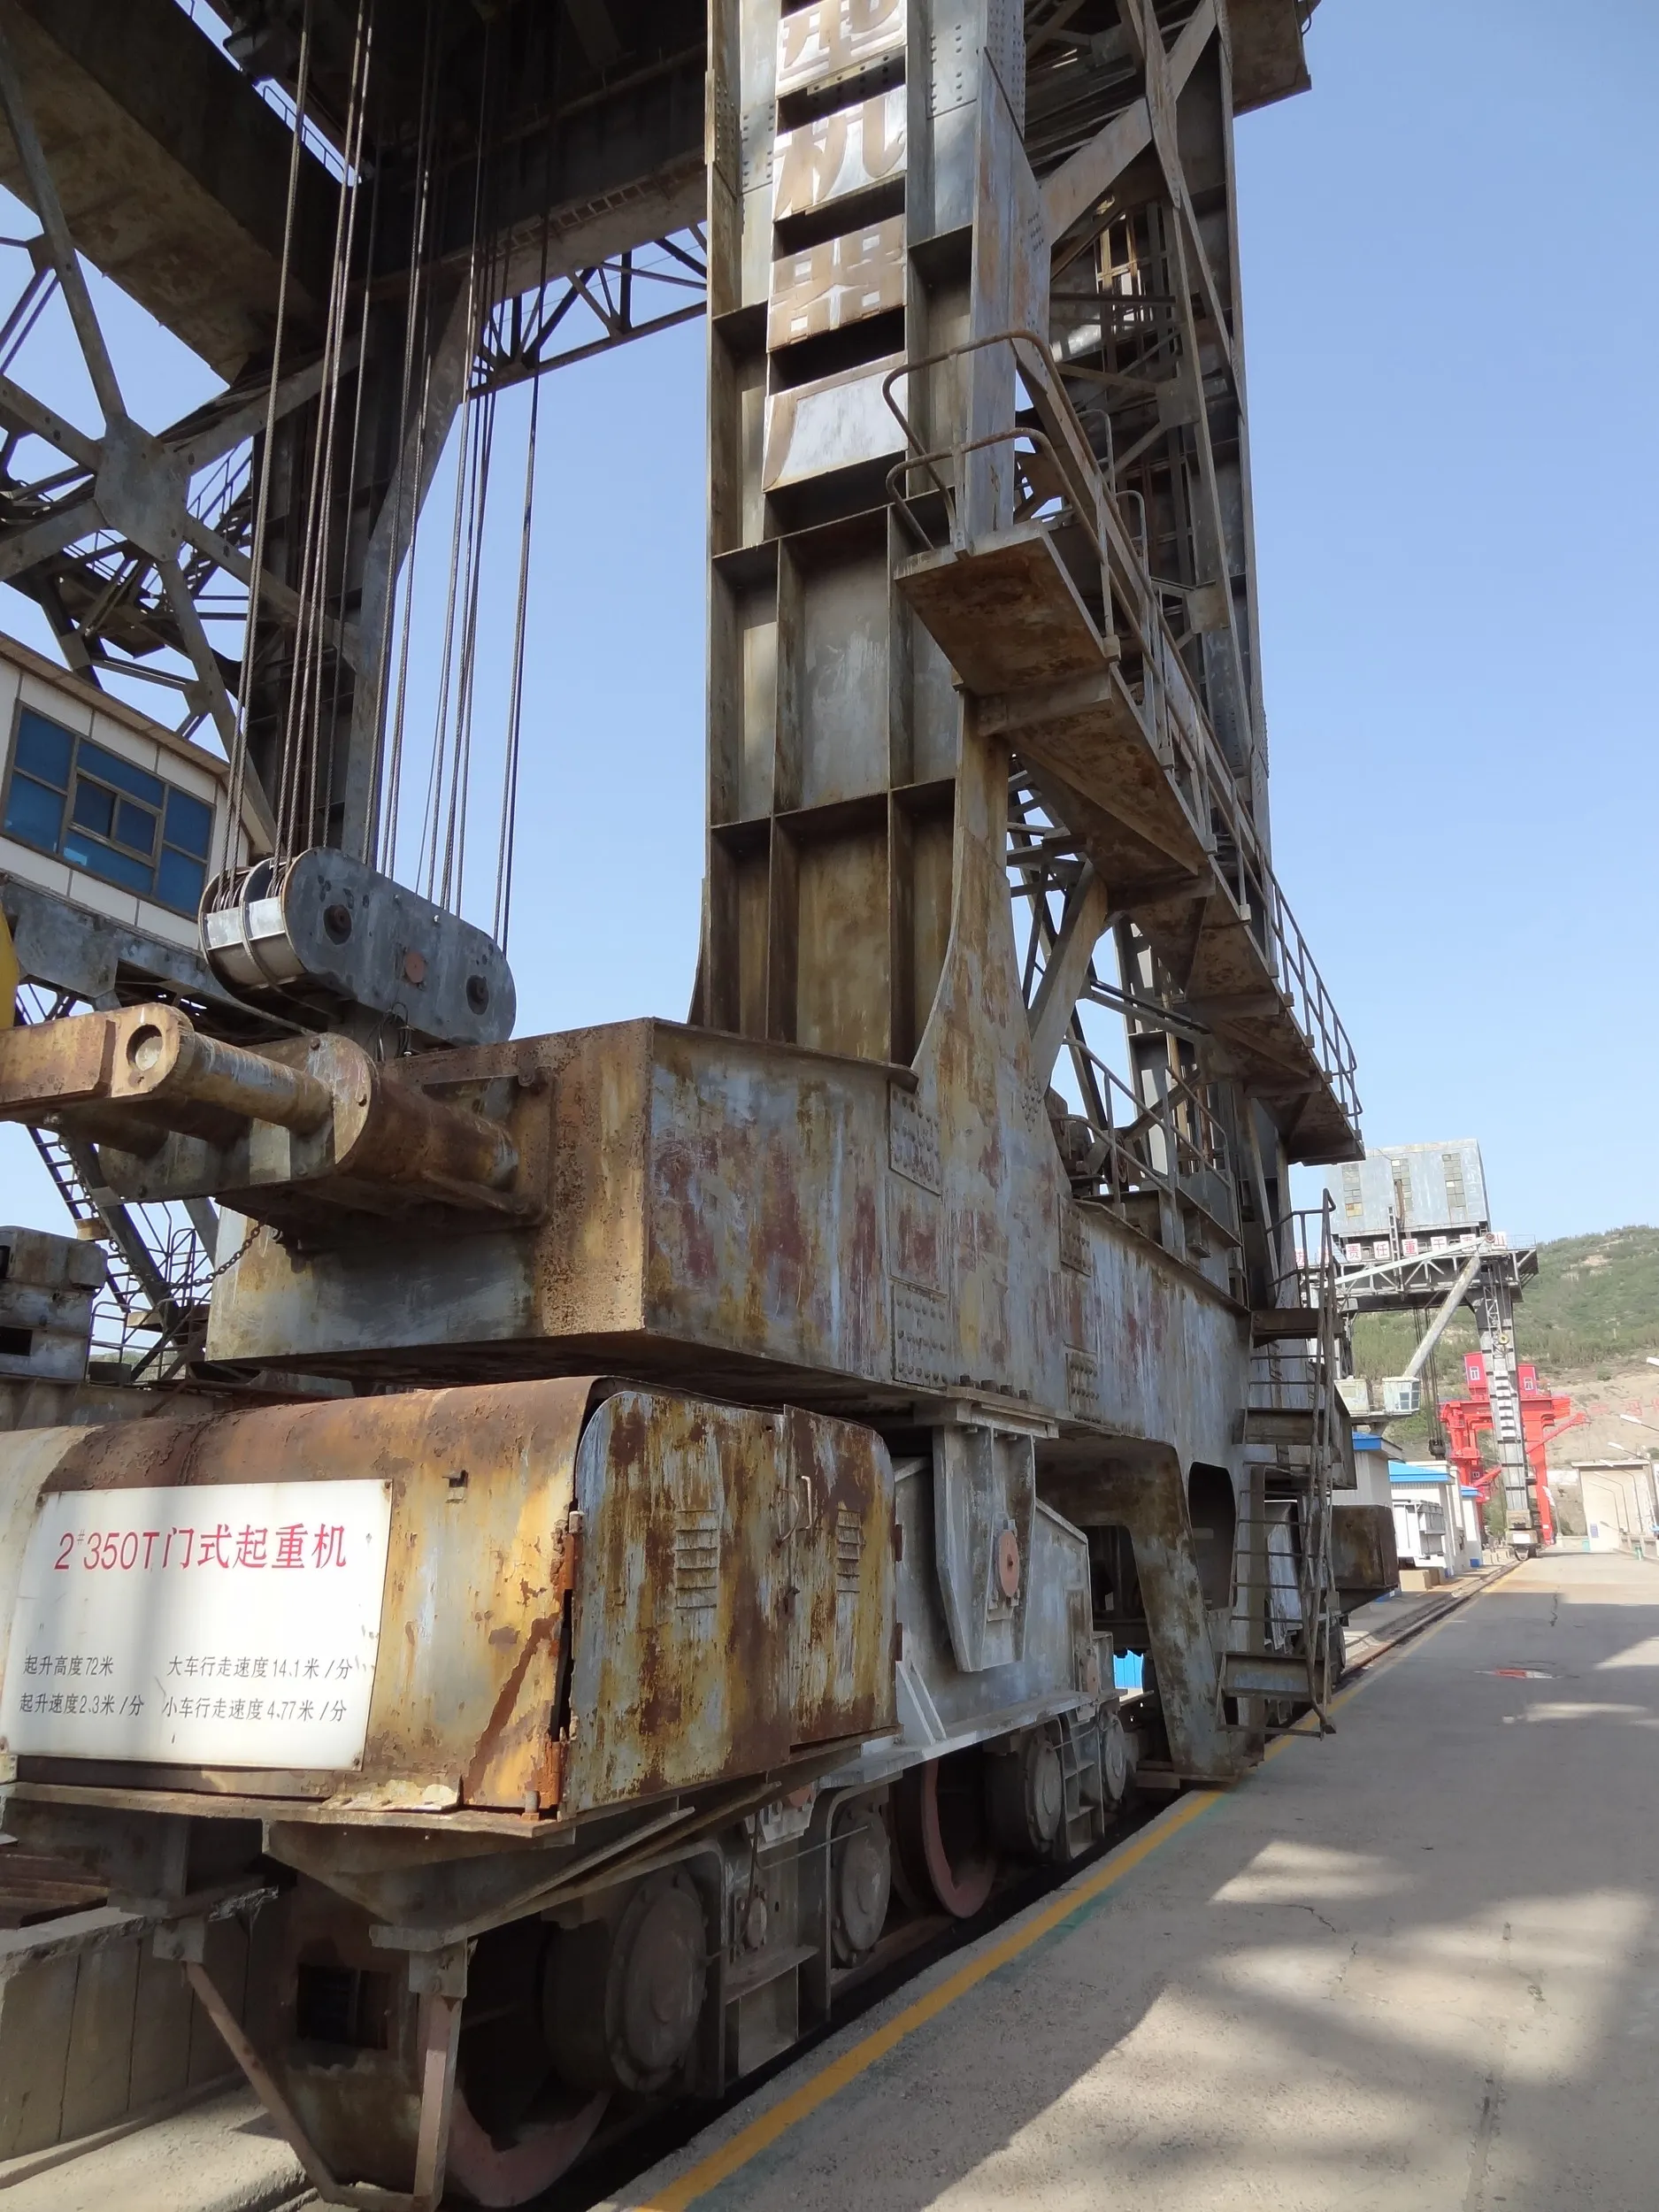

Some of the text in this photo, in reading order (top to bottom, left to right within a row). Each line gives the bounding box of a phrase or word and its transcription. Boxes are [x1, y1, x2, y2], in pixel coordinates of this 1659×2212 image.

[53, 1523, 347, 1571] 2#350T门式起重机
[23, 1654, 114, 1677] 起升高度72米
